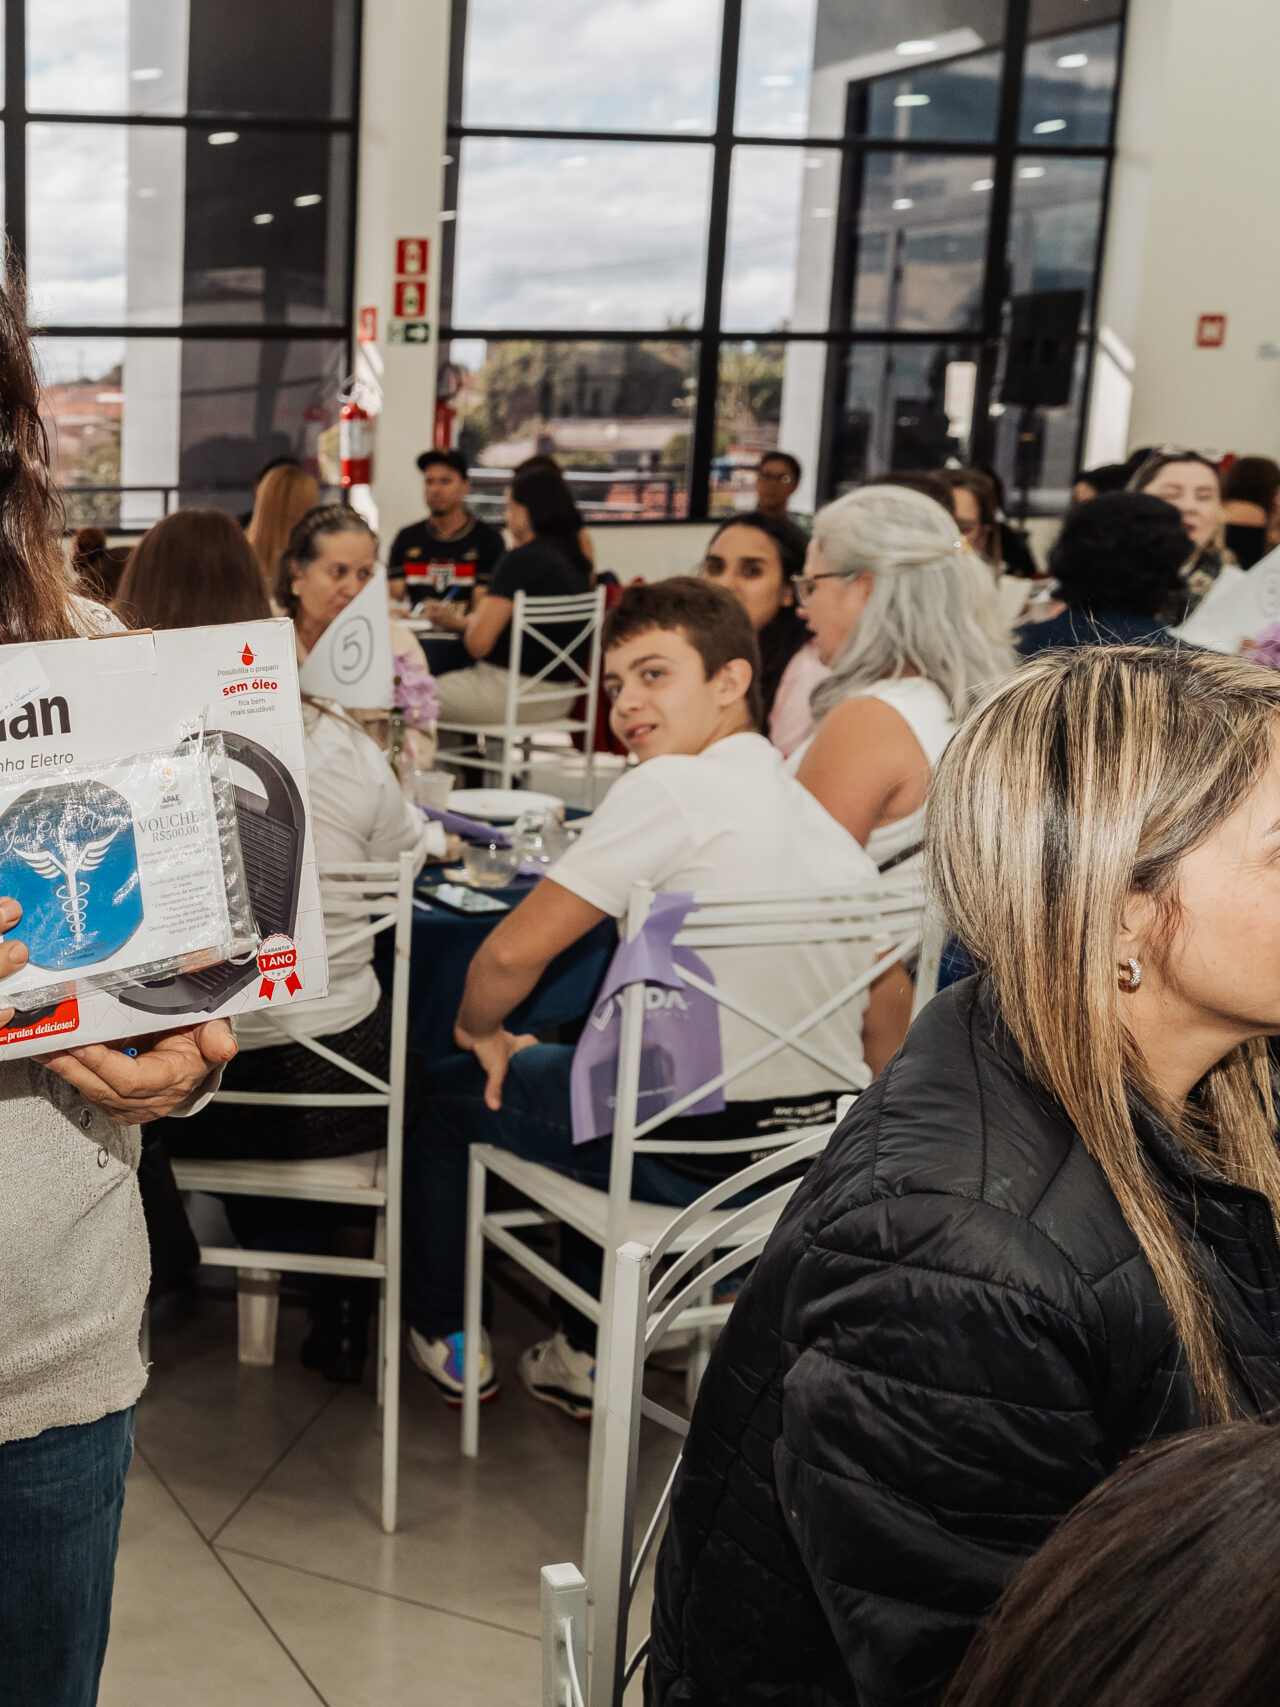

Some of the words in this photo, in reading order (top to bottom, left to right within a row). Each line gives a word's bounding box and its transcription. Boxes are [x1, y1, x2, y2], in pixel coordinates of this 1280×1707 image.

[342, 630, 363, 672] 5
[255, 664, 279, 673] preparo
[222, 683, 248, 696] sem
[252, 678, 278, 690] óleo
[251, 697, 266, 705] bem
[230, 708, 246, 717] mais
[30, 753, 74, 769] Eletro
[162, 794, 180, 804] APAE
[138, 811, 205, 833] VOUCHE
[264, 945, 290, 953] GARANTIA
[261, 958, 266, 968] 1
[269, 953, 294, 967] ANO
[7, 1028, 33, 1042] pratos
[35, 1018, 76, 1035] deliciosos!
